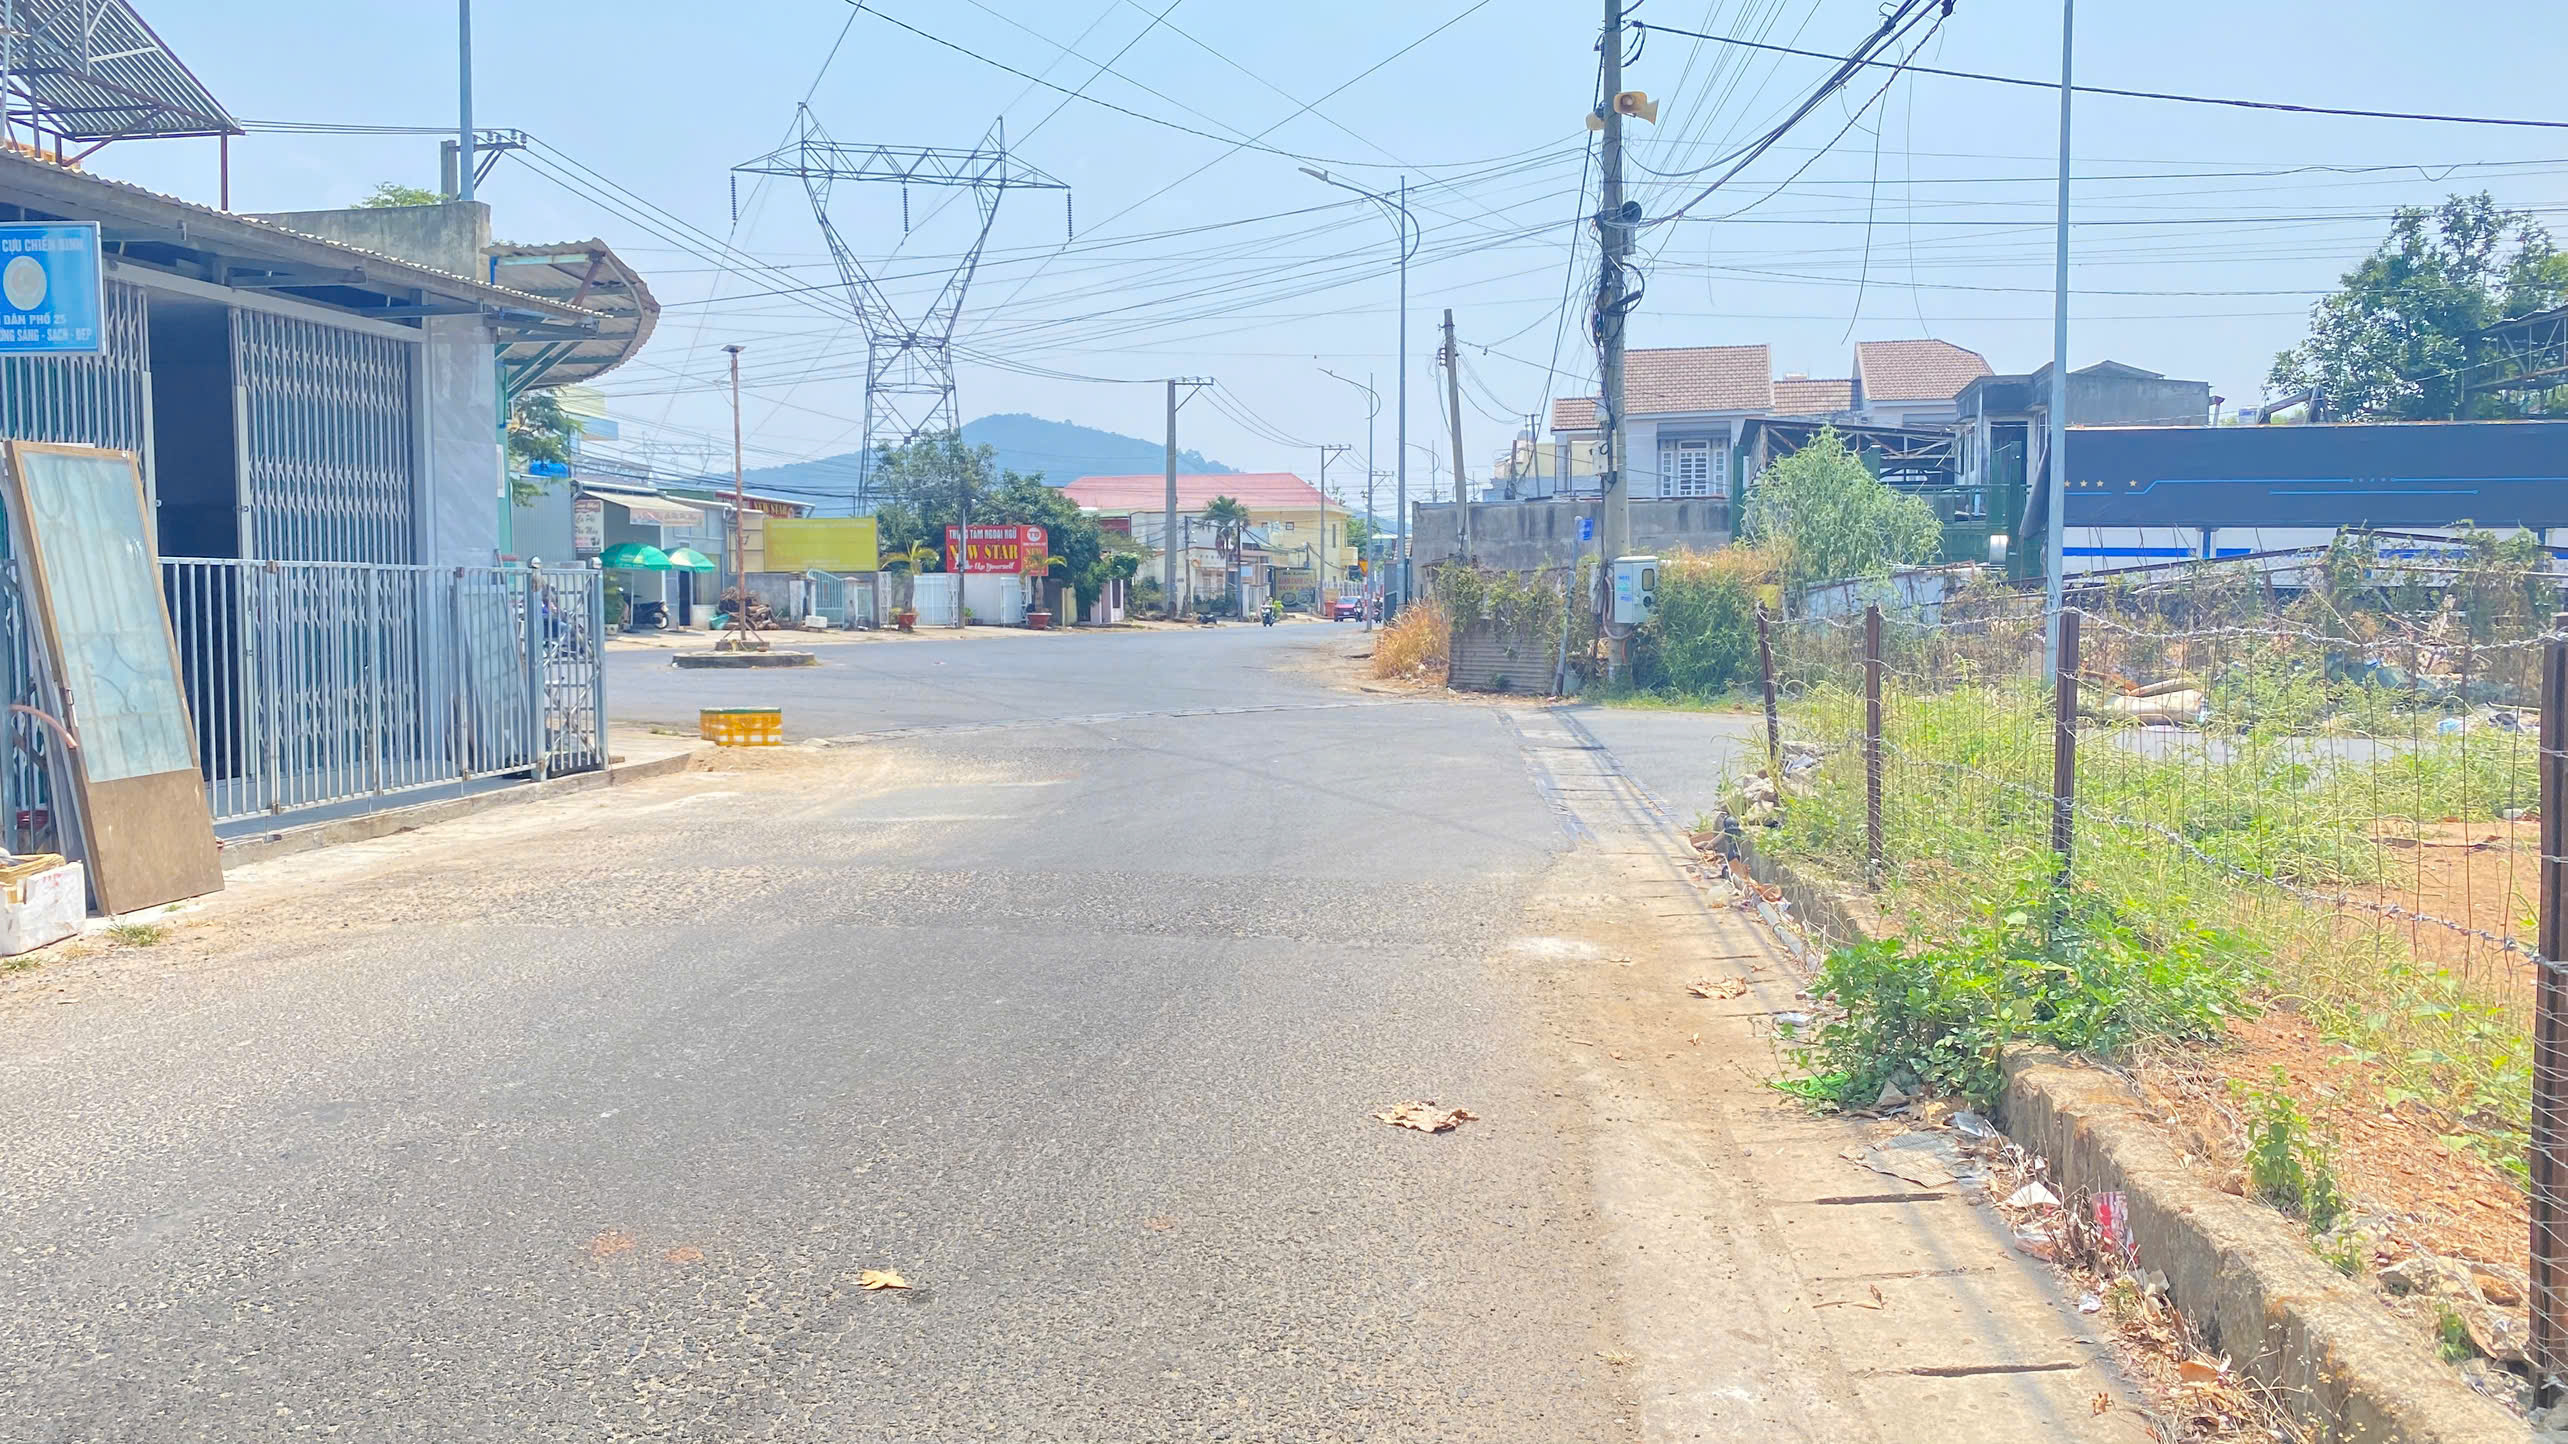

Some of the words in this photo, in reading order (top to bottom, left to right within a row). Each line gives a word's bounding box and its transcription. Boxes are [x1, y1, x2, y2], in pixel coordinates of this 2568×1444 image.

[3, 312, 26, 325] DÂN
[29, 312, 51, 325] PHỐ
[949, 544, 979, 560] NW
[984, 544, 1018, 560] STAR
